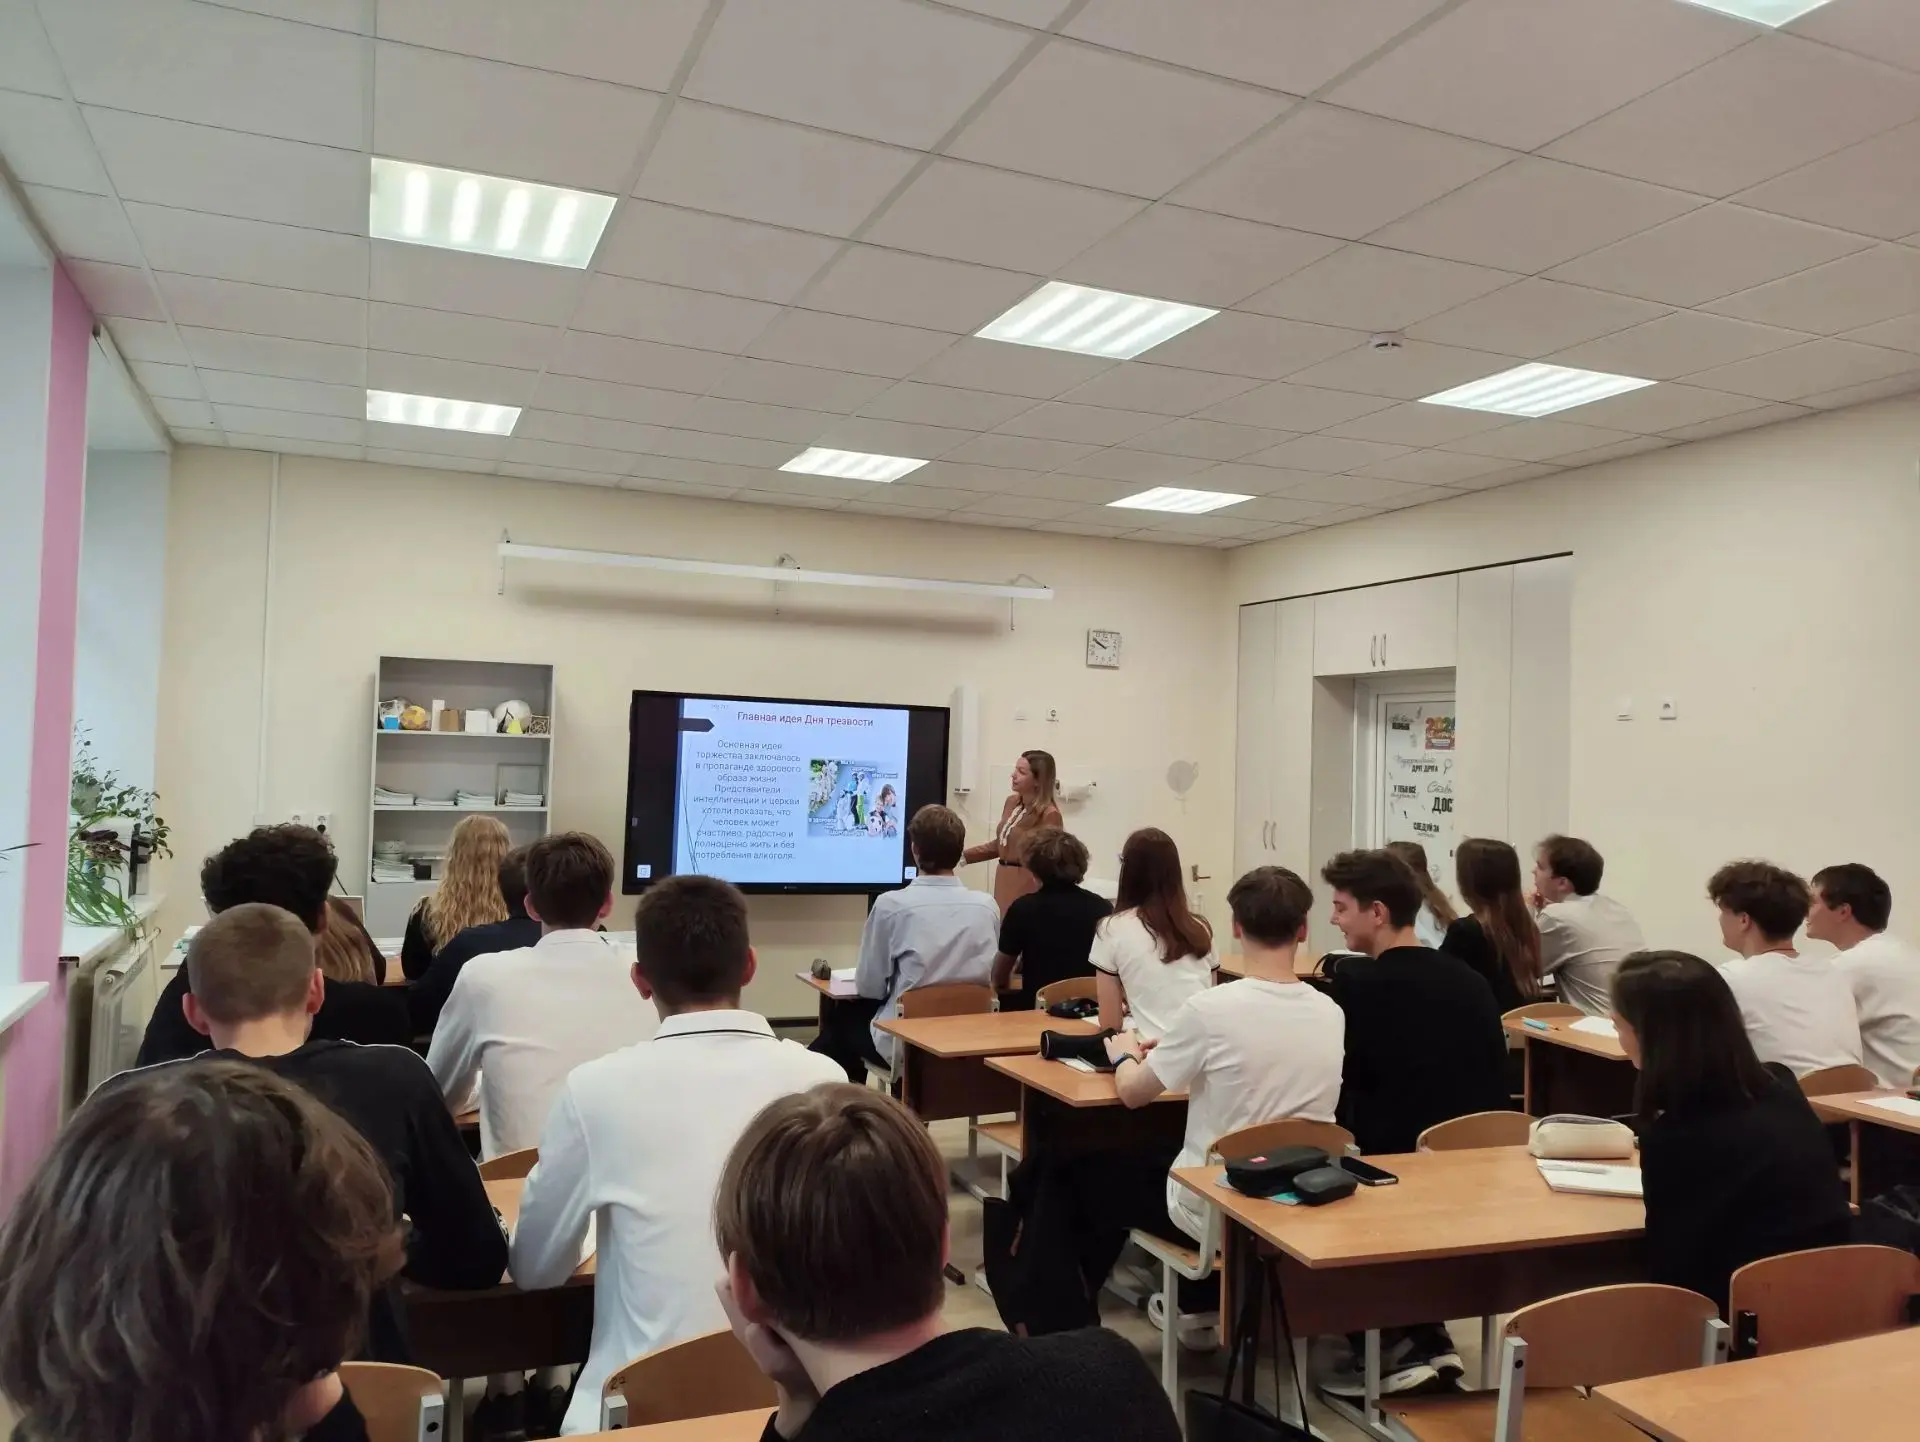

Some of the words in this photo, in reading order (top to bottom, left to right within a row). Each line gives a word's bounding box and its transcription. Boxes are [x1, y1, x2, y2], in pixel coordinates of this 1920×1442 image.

[737, 711, 777, 723] Главная
[779, 715, 803, 726] идея
[804, 715, 824, 725] Дня
[826, 717, 874, 728] трезвости
[717, 739, 760, 750] Основная
[761, 741, 783, 751] идея
[697, 751, 743, 762] торжества
[744, 753, 801, 763] заключалась
[703, 763, 754, 773] пропаганде
[756, 765, 802, 774] здорового
[717, 773, 748, 783] образа
[714, 784, 781, 794] Представители
[693, 795, 760, 805] интеллигенции
[769, 798, 800, 807] церкви
[702, 807, 732, 815] хотели
[733, 808, 775, 817] показать,
[713, 819, 750, 827] человек
[751, 819, 780, 827] может
[745, 830, 787, 839] радостно
[696, 841, 748, 849] полноценно
[780, 841, 795, 849] без
